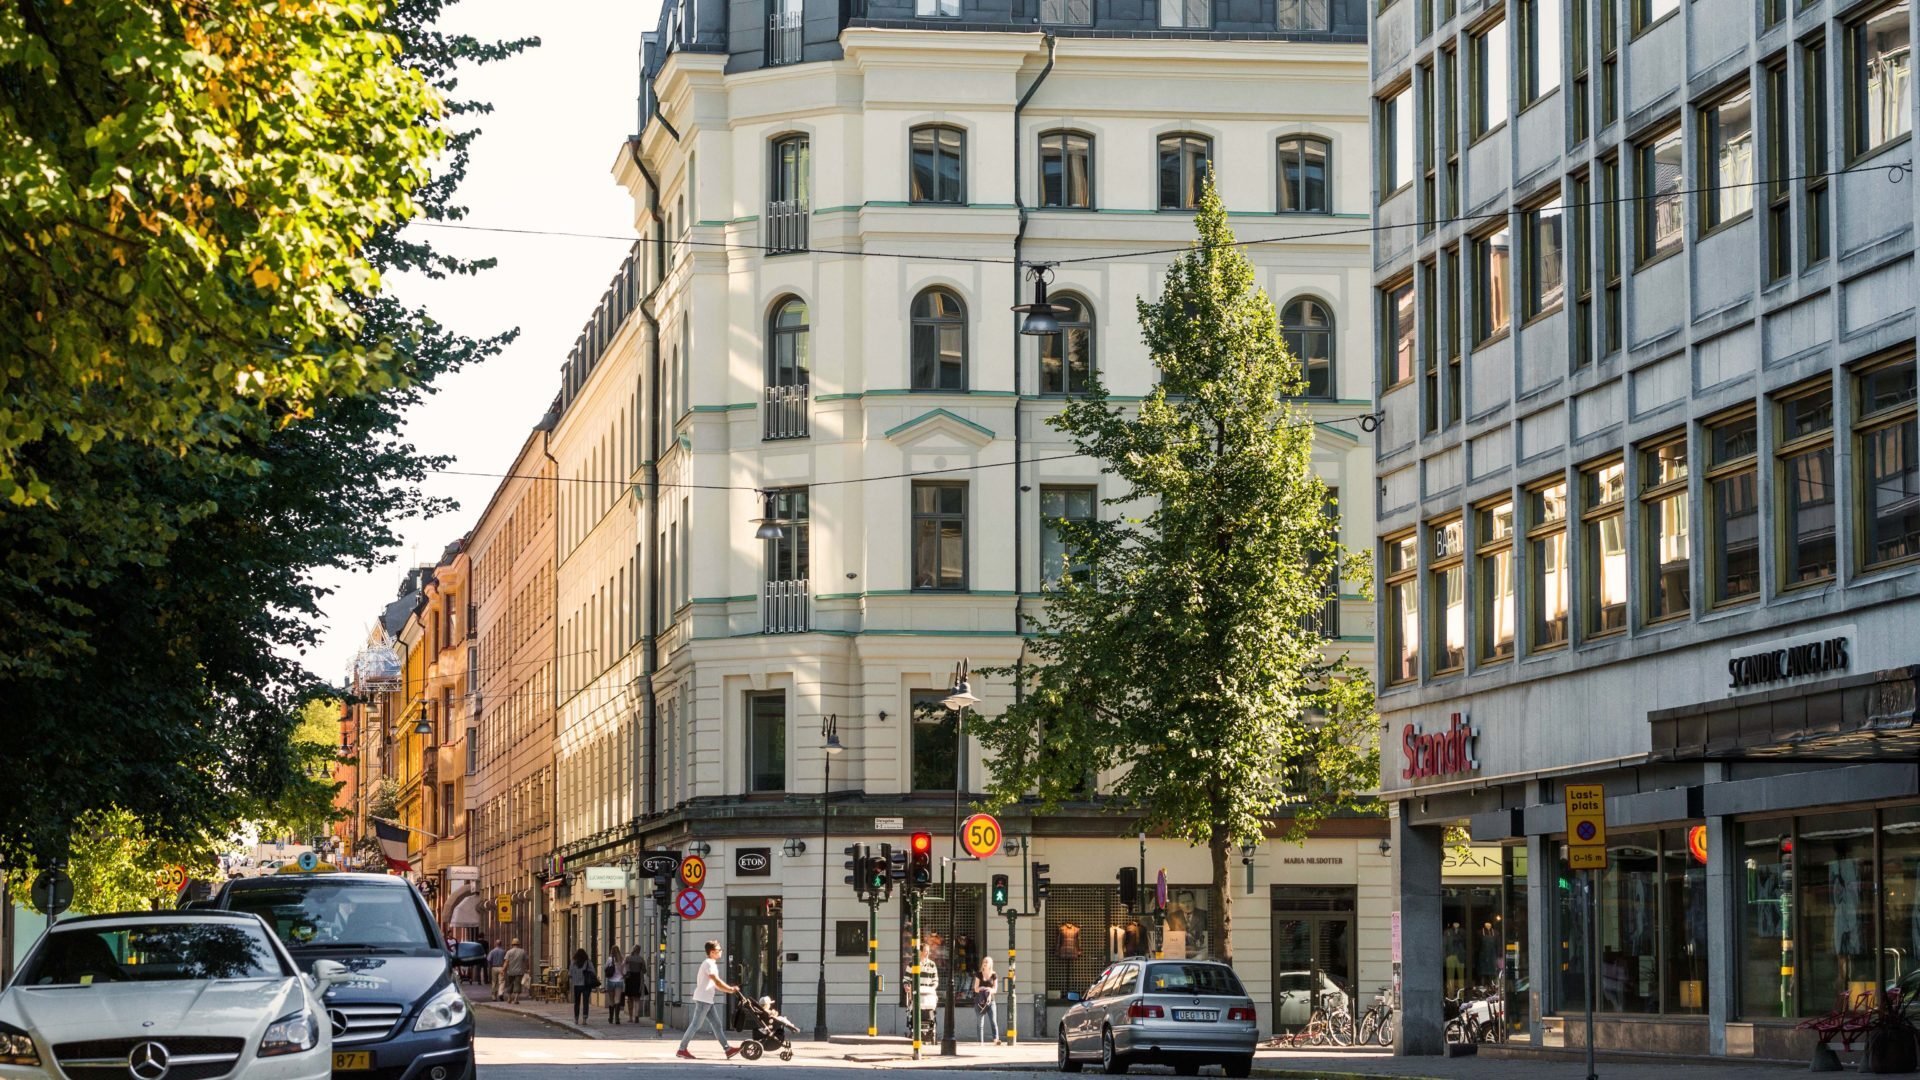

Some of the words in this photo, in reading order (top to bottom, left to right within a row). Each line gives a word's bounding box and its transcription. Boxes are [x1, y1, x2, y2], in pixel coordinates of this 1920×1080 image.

[1729, 649, 1787, 688] SCANDIC
[1787, 637, 1848, 678] ANGLAIS
[1403, 712, 1476, 779] Scandic
[1570, 790, 1599, 799] Last-
[1572, 802, 1599, 812] plats
[971, 826, 995, 846] 50
[742, 858, 763, 866] ETON
[1573, 854, 1593, 862] 0-15
[685, 863, 702, 878] 30
[336, 1054, 355, 1068] 87
